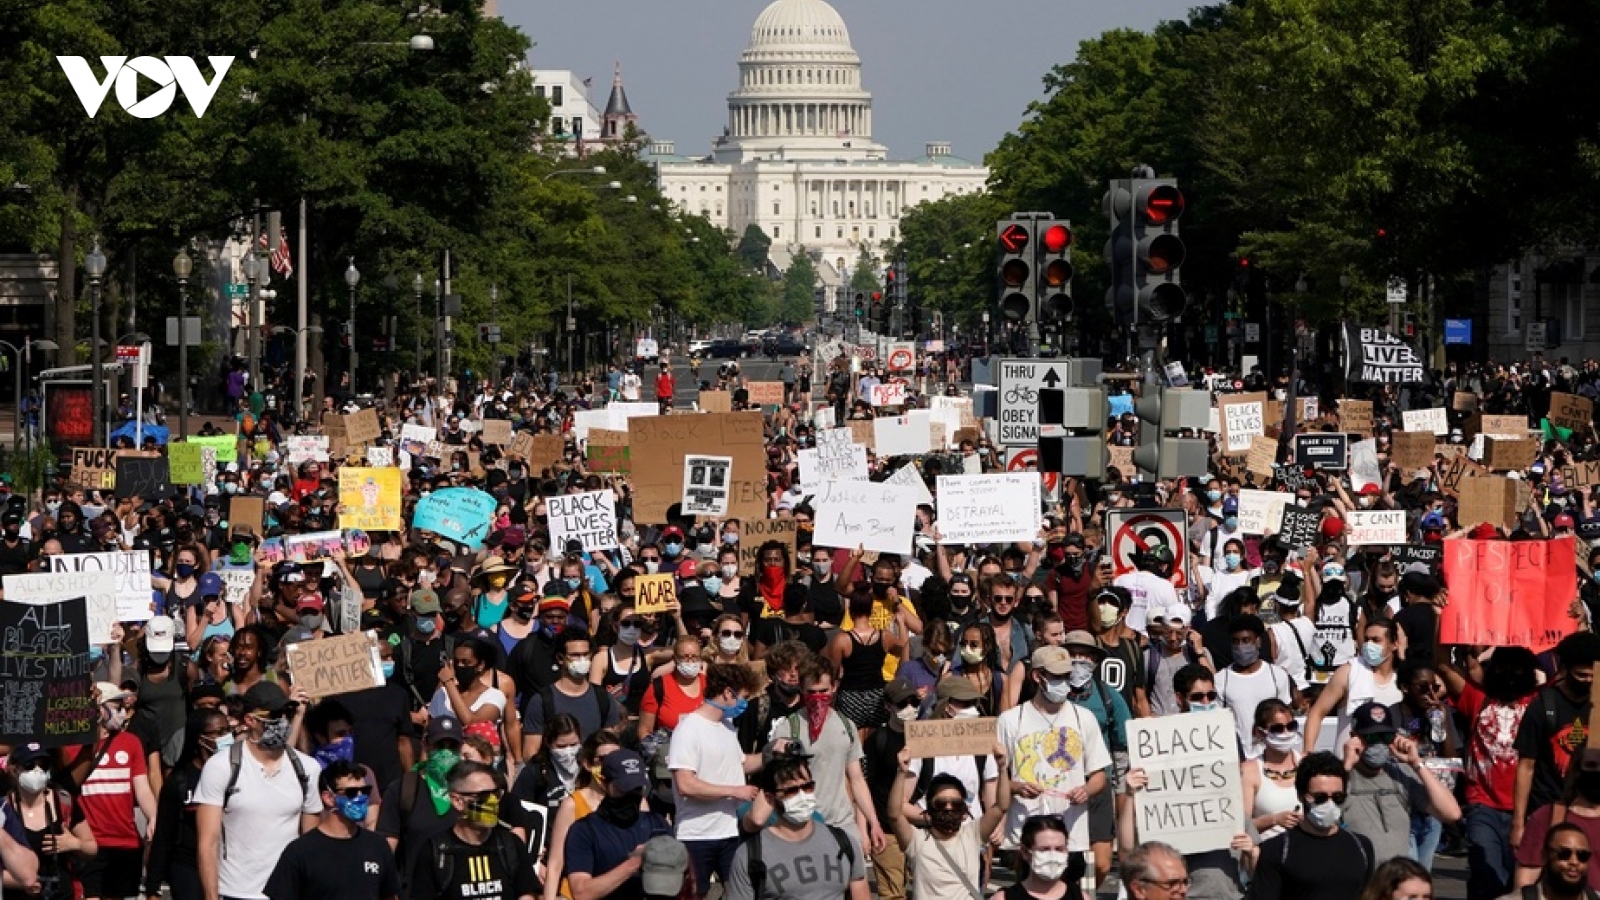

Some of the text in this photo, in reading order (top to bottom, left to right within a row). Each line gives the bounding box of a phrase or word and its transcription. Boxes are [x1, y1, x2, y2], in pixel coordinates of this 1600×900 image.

[1360, 328, 1401, 344] BLA
[1004, 365, 1035, 379] THRU
[1362, 365, 1423, 383] MATTER
[1003, 410, 1035, 422] OBEY
[1227, 404, 1260, 418] BLACK
[1002, 425, 1037, 440] SIGNA
[1229, 417, 1261, 430] LIVES
[74, 451, 115, 469] FUCK
[817, 443, 853, 460] LIVES
[1564, 461, 1599, 488] BLM
[821, 480, 867, 504] Justice
[549, 492, 610, 518] BLACK
[946, 504, 1005, 521] BETRAYAL
[565, 513, 613, 531] LIVES
[746, 521, 764, 535] NO
[1280, 511, 1296, 544] BLACK
[1407, 548, 1437, 559] RACIST
[14, 574, 100, 593] ALLYSHIP
[638, 580, 676, 606] ACAB
[17, 603, 72, 630] ALL
[3, 626, 73, 654] BLACK
[294, 646, 338, 669] BLACK
[315, 660, 372, 688] MATTER
[45, 720, 91, 734] MUSLIMS
[908, 723, 938, 738] BLACK
[941, 722, 965, 738] LIVES
[1137, 725, 1225, 759] BLACK
[1145, 760, 1227, 793] LIVES
[1143, 797, 1236, 832] MATTER
[364, 861, 379, 875] PR
[768, 853, 844, 893] PGH
[461, 880, 503, 897] BLACK
